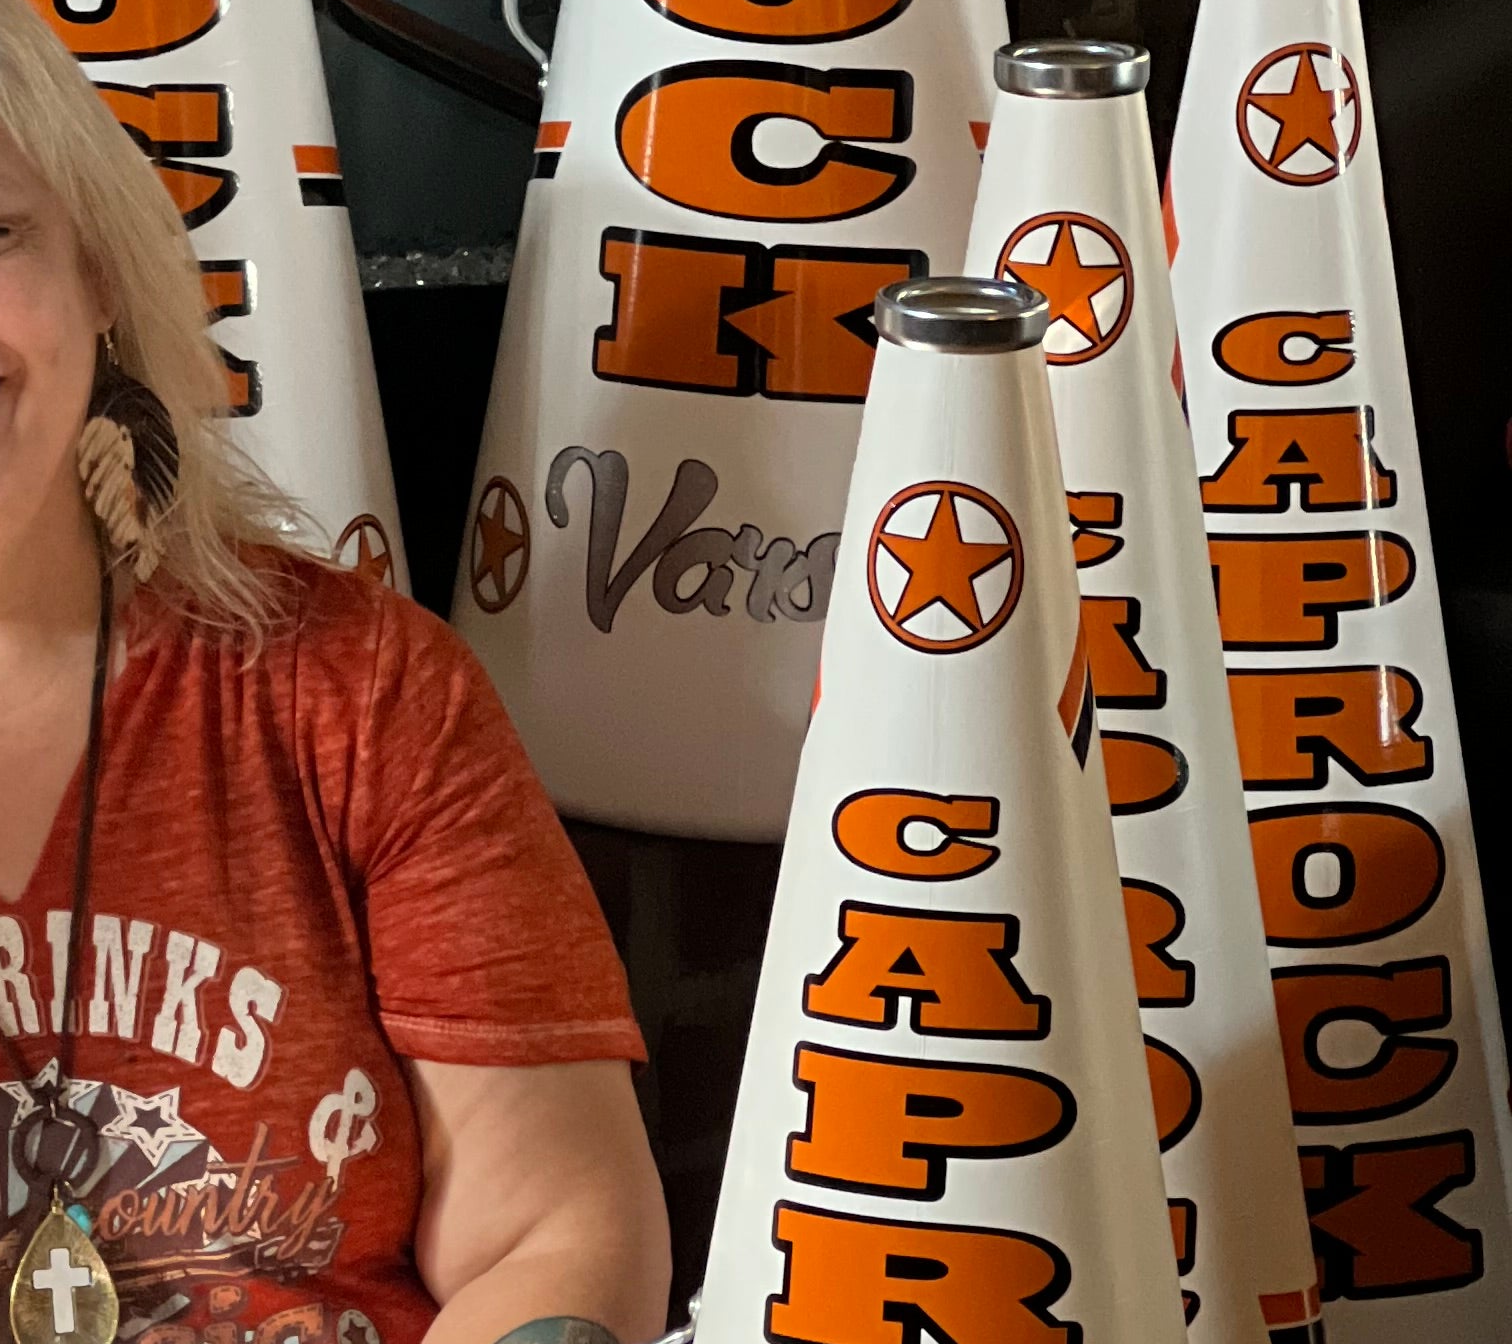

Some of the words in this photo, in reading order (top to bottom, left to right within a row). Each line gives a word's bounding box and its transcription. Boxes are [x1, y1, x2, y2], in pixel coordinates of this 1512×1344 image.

[545, 445, 842, 634] Vars
[93, 1121, 338, 1258] ountry
[309, 1067, 382, 1192] &
